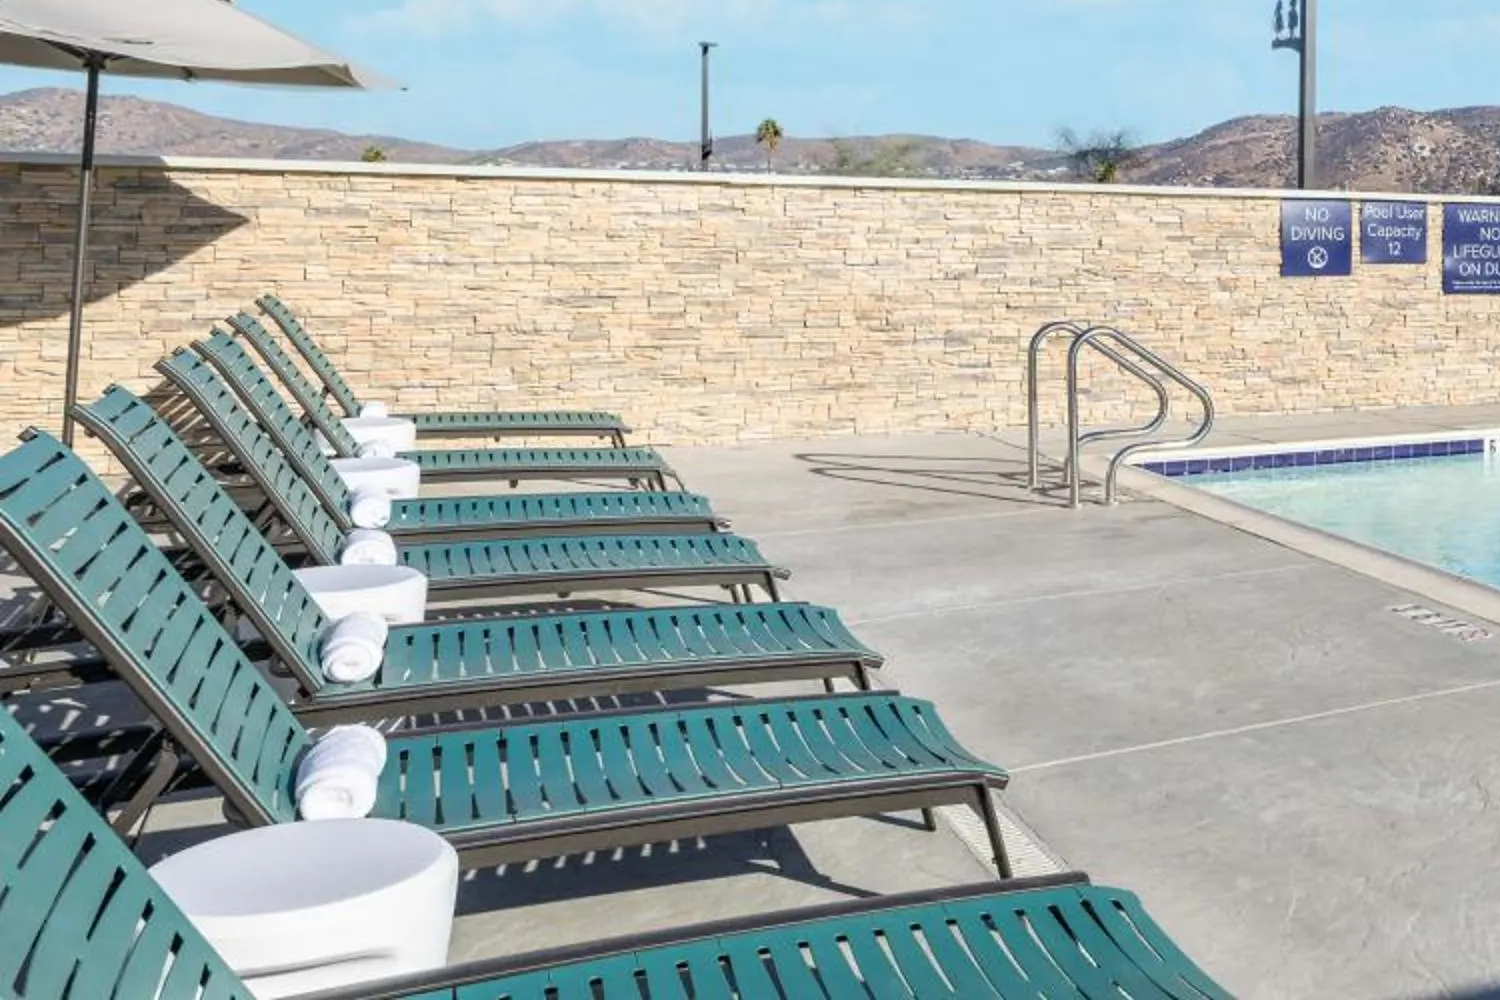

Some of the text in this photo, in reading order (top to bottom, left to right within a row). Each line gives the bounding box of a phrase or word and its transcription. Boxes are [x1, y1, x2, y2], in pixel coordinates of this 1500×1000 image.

[1304, 206, 1329, 221] NO
[1365, 205, 1393, 219] Pool
[1291, 226, 1345, 241] DIVING
[1367, 223, 1423, 240] Capacity
[1388, 244, 1401, 256] 12
[1459, 262, 1483, 277] ON
